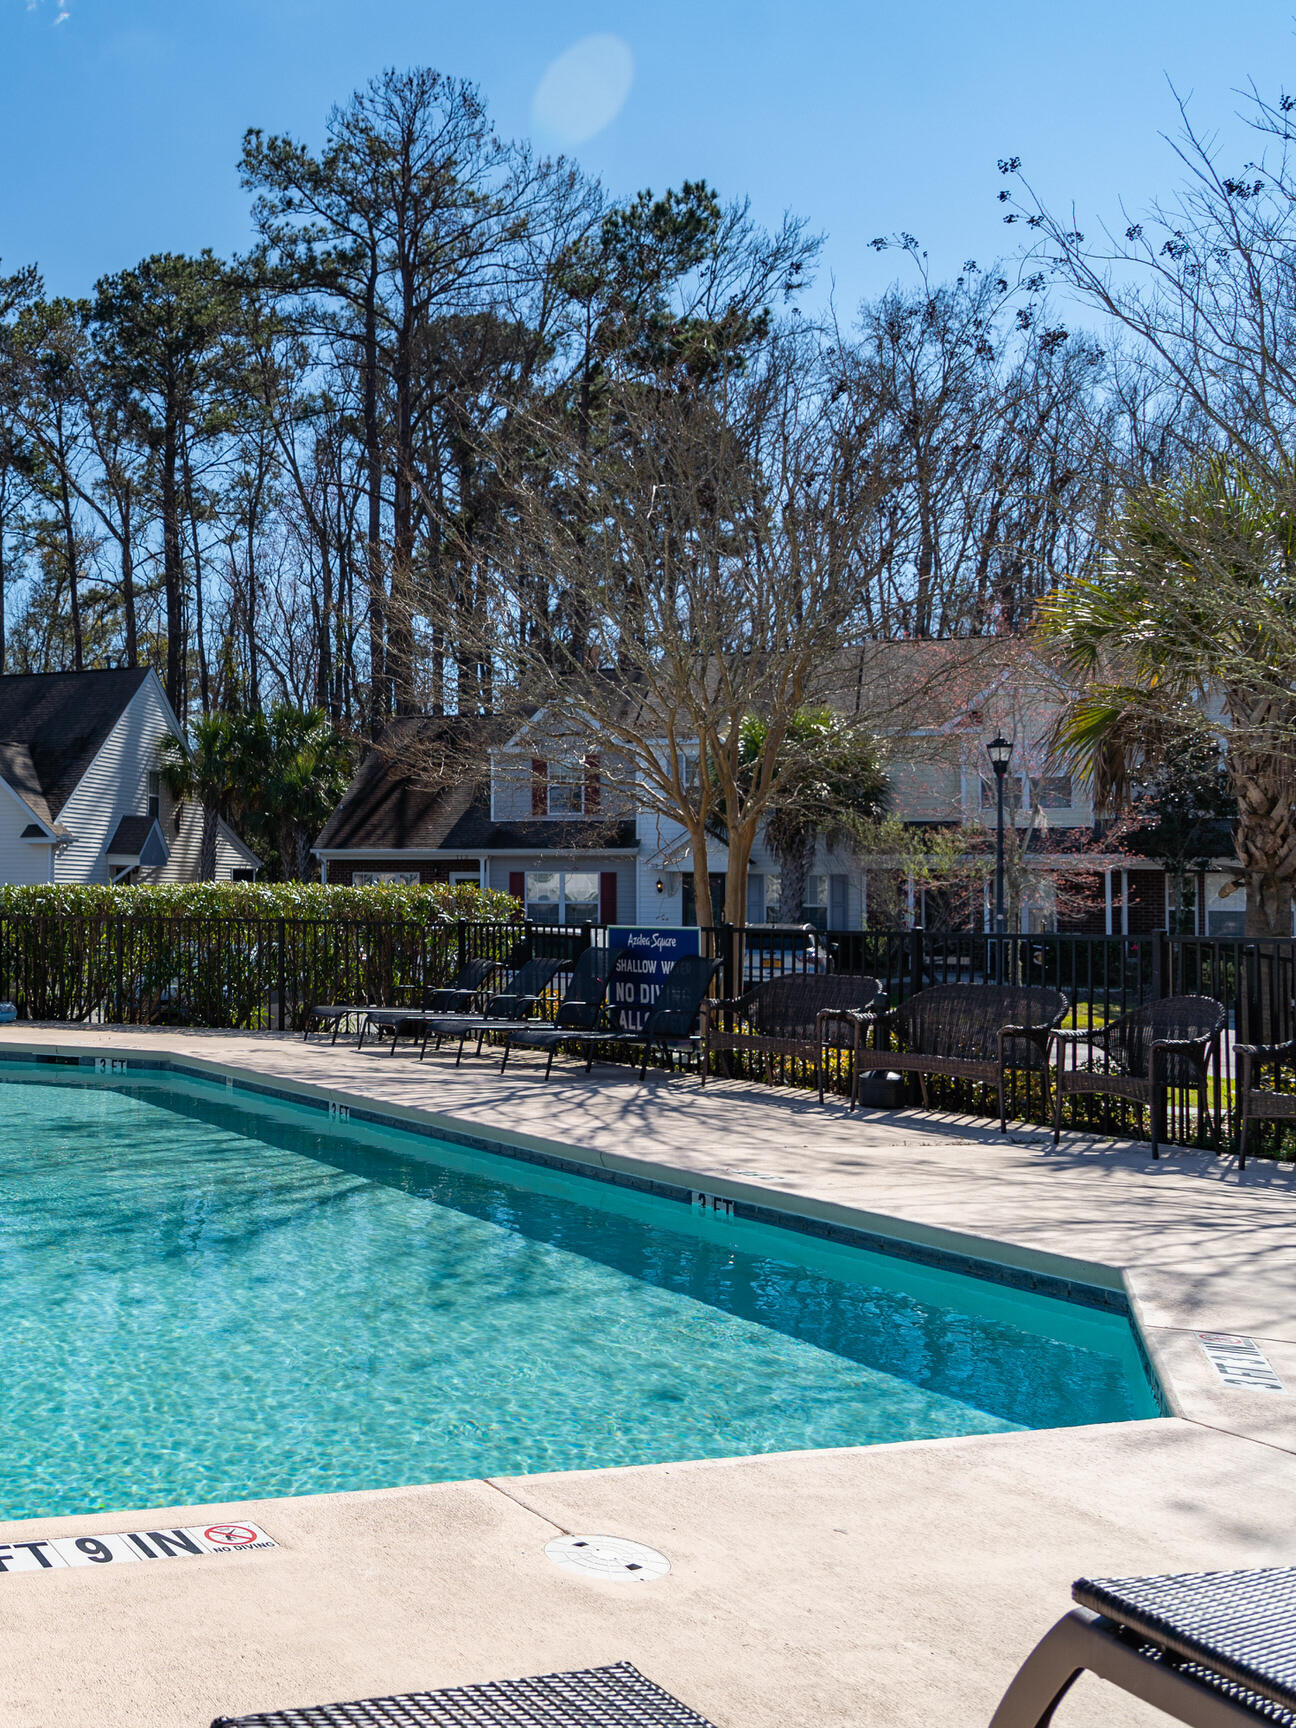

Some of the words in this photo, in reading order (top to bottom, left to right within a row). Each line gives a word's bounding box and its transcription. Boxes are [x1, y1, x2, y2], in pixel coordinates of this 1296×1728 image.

[651, 933, 677, 952] Square
[615, 959, 657, 974] SHALLOW
[615, 982, 635, 1003] NO
[75, 1537, 113, 1563] 9
[127, 1530, 204, 1558] IN
[233, 1541, 275, 1551] DIVING
